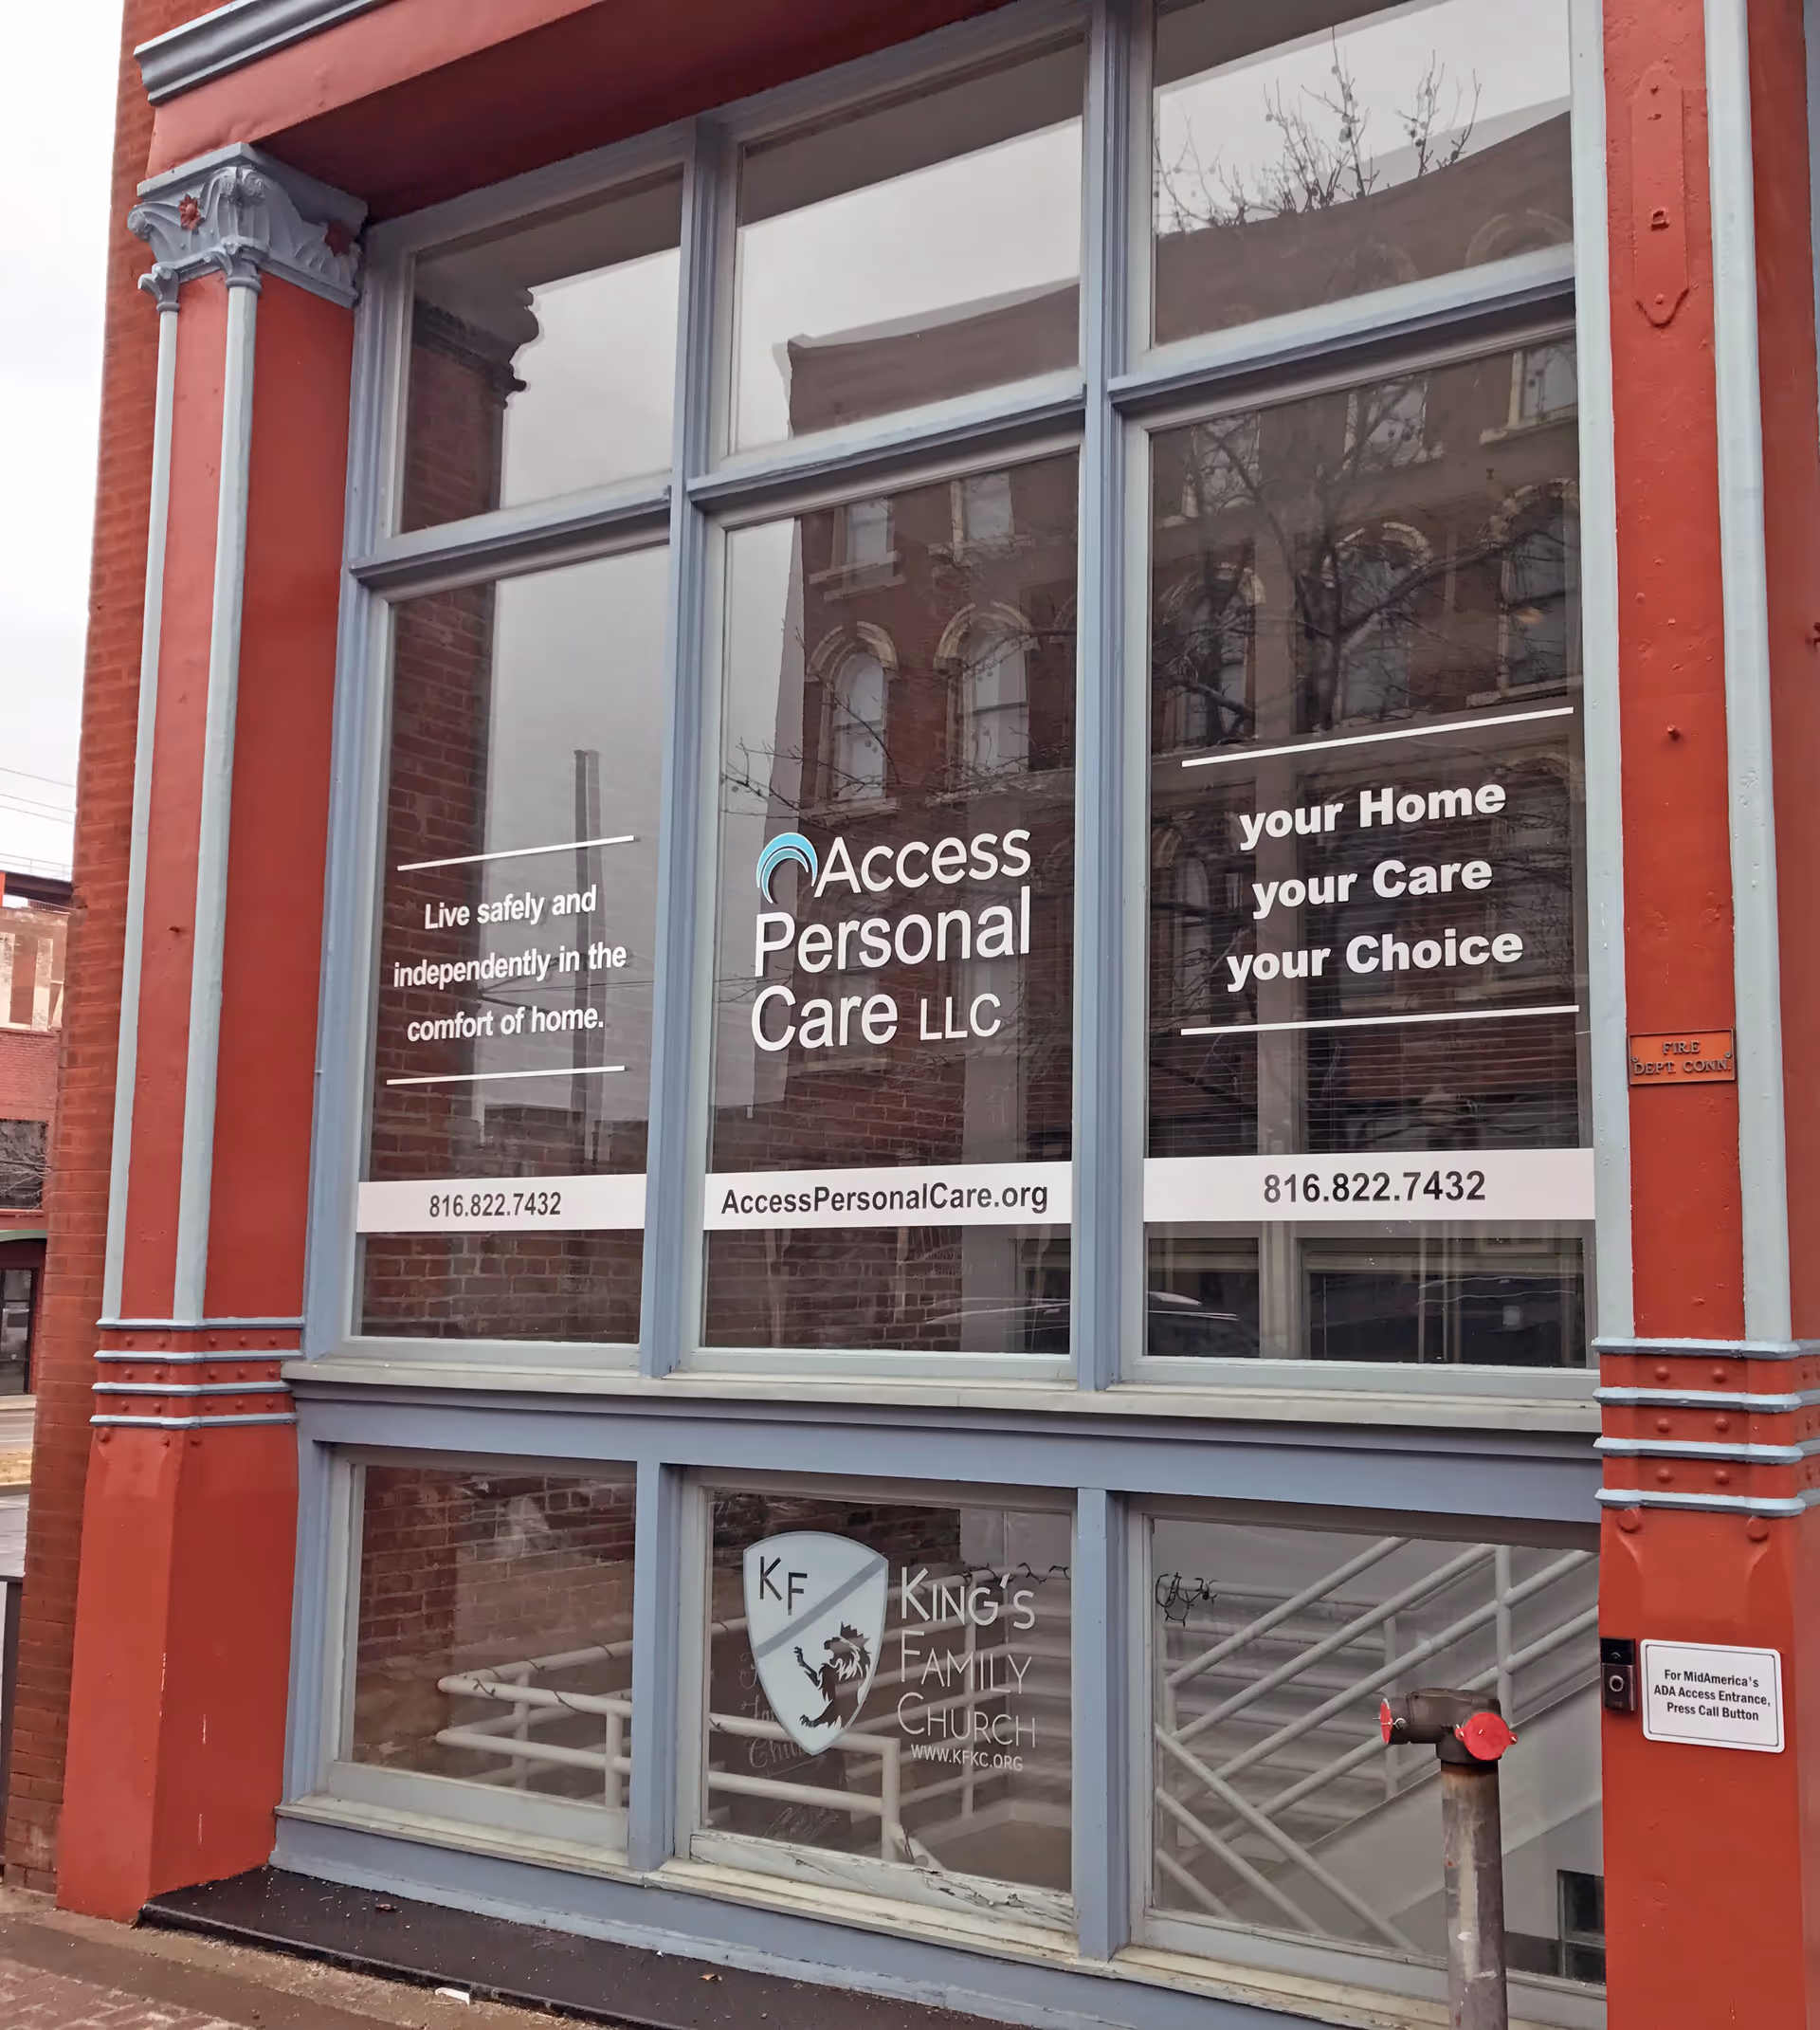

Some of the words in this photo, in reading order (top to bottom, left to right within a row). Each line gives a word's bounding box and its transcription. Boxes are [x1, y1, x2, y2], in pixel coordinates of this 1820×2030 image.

[1239, 802, 1344, 850] your
[1359, 783, 1507, 829] Home
[813, 829, 1032, 899] Access
[425, 902, 471, 930] Live
[477, 891, 546, 925] safely
[551, 884, 598, 916] and
[1251, 873, 1358, 920] your
[1373, 860, 1493, 899] Care
[754, 885, 1031, 978] Personal
[392, 945, 552, 990] independently
[557, 944, 581, 973] in
[588, 941, 628, 970] the
[1226, 948, 1332, 994] your
[1345, 928, 1524, 974] Choice
[407, 1009, 495, 1042] comfort
[500, 1006, 526, 1036] of
[531, 1005, 605, 1033] home.
[751, 984, 900, 1052] Care
[919, 993, 1002, 1041] LLC
[1663, 1040, 1701, 1054] FIRE
[428, 1190, 562, 1219] 816.822.7432
[720, 1180, 1048, 1215] AccessPersonalCare.org
[1263, 1169, 1486, 1203] 816.822.7432
[901, 1629, 1032, 1694] FAMILY
[1664, 1669, 1682, 1681] For
[1684, 1671, 1759, 1688] MidAmerica's
[1654, 1685, 1676, 1696] ADA
[1678, 1687, 1716, 1700] Access
[1719, 1691, 1771, 1707] Entrance,
[1666, 1702, 1696, 1715] Press
[1698, 1705, 1720, 1717] Call
[1721, 1708, 1759, 1721] Button
[897, 1692, 1036, 1748] CHURCH
[911, 1743, 1024, 1771] WWW.KFKC.ORG
